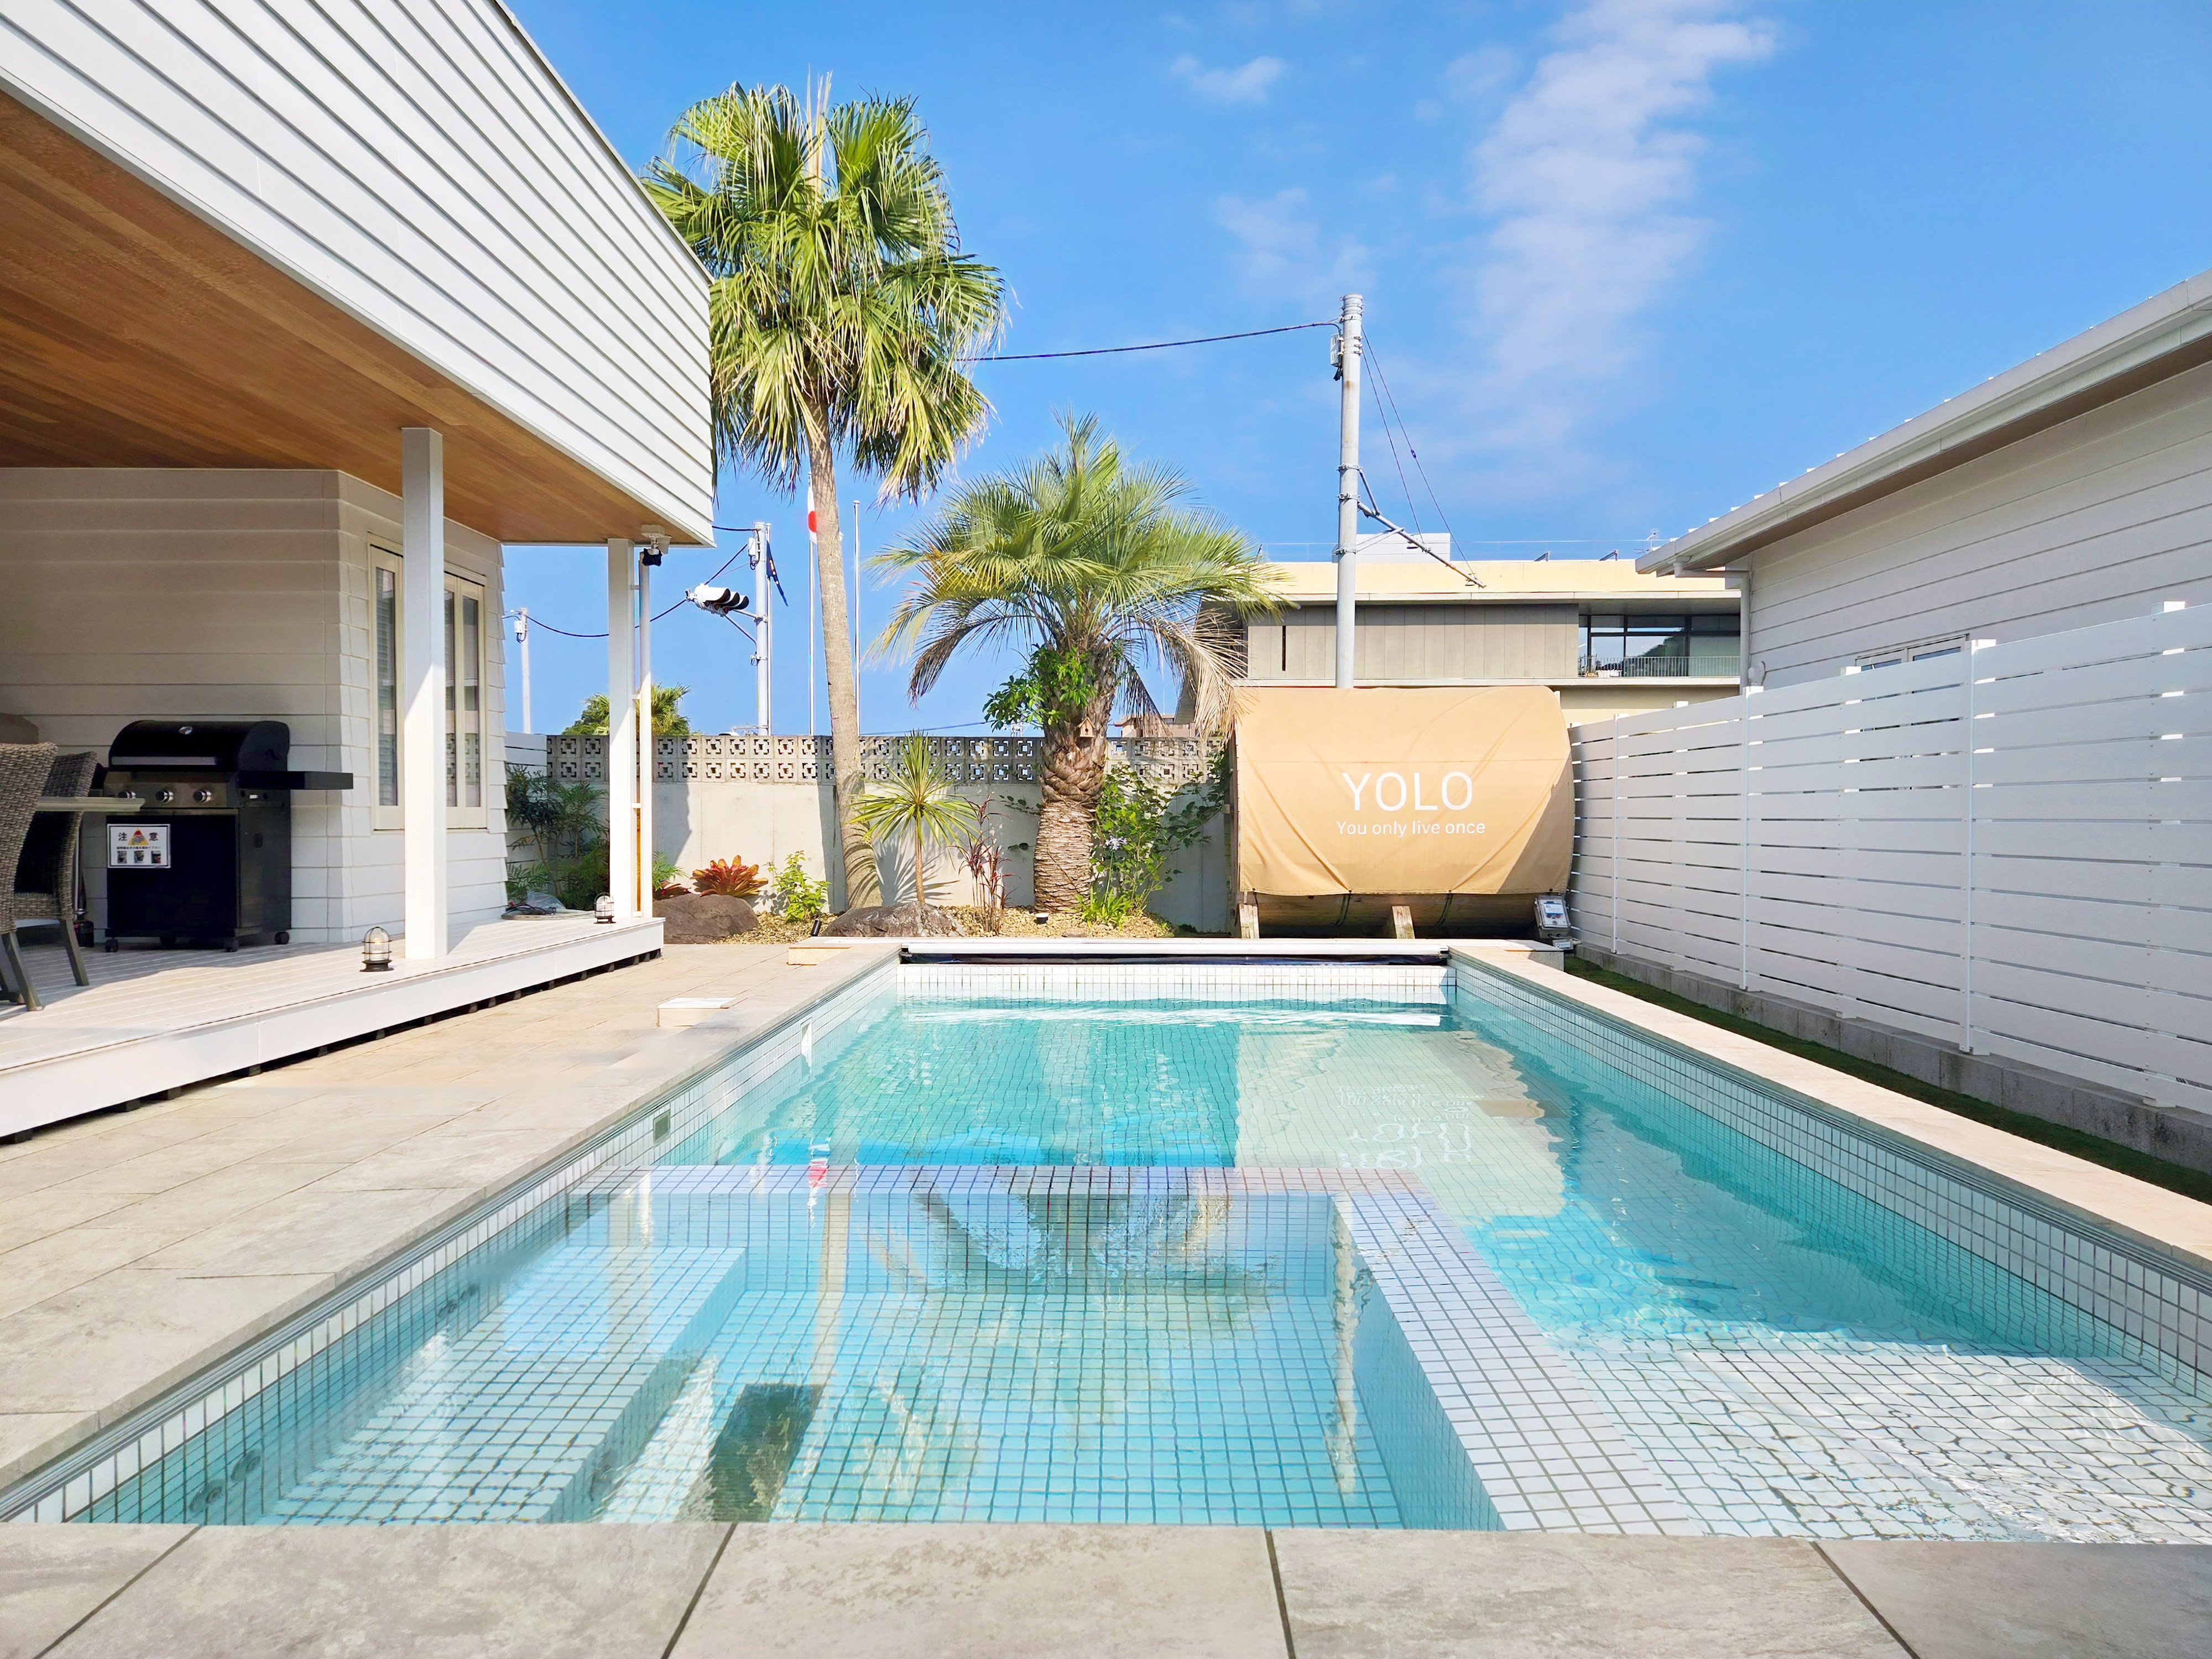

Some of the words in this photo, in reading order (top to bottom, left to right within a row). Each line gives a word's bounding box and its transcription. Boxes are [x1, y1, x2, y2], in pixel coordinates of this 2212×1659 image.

[1342, 771, 1473, 811] YOLO
[1337, 821, 1366, 834] You
[1372, 821, 1407, 838] only
[1412, 820, 1441, 834] live
[1445, 822, 1485, 834] once
